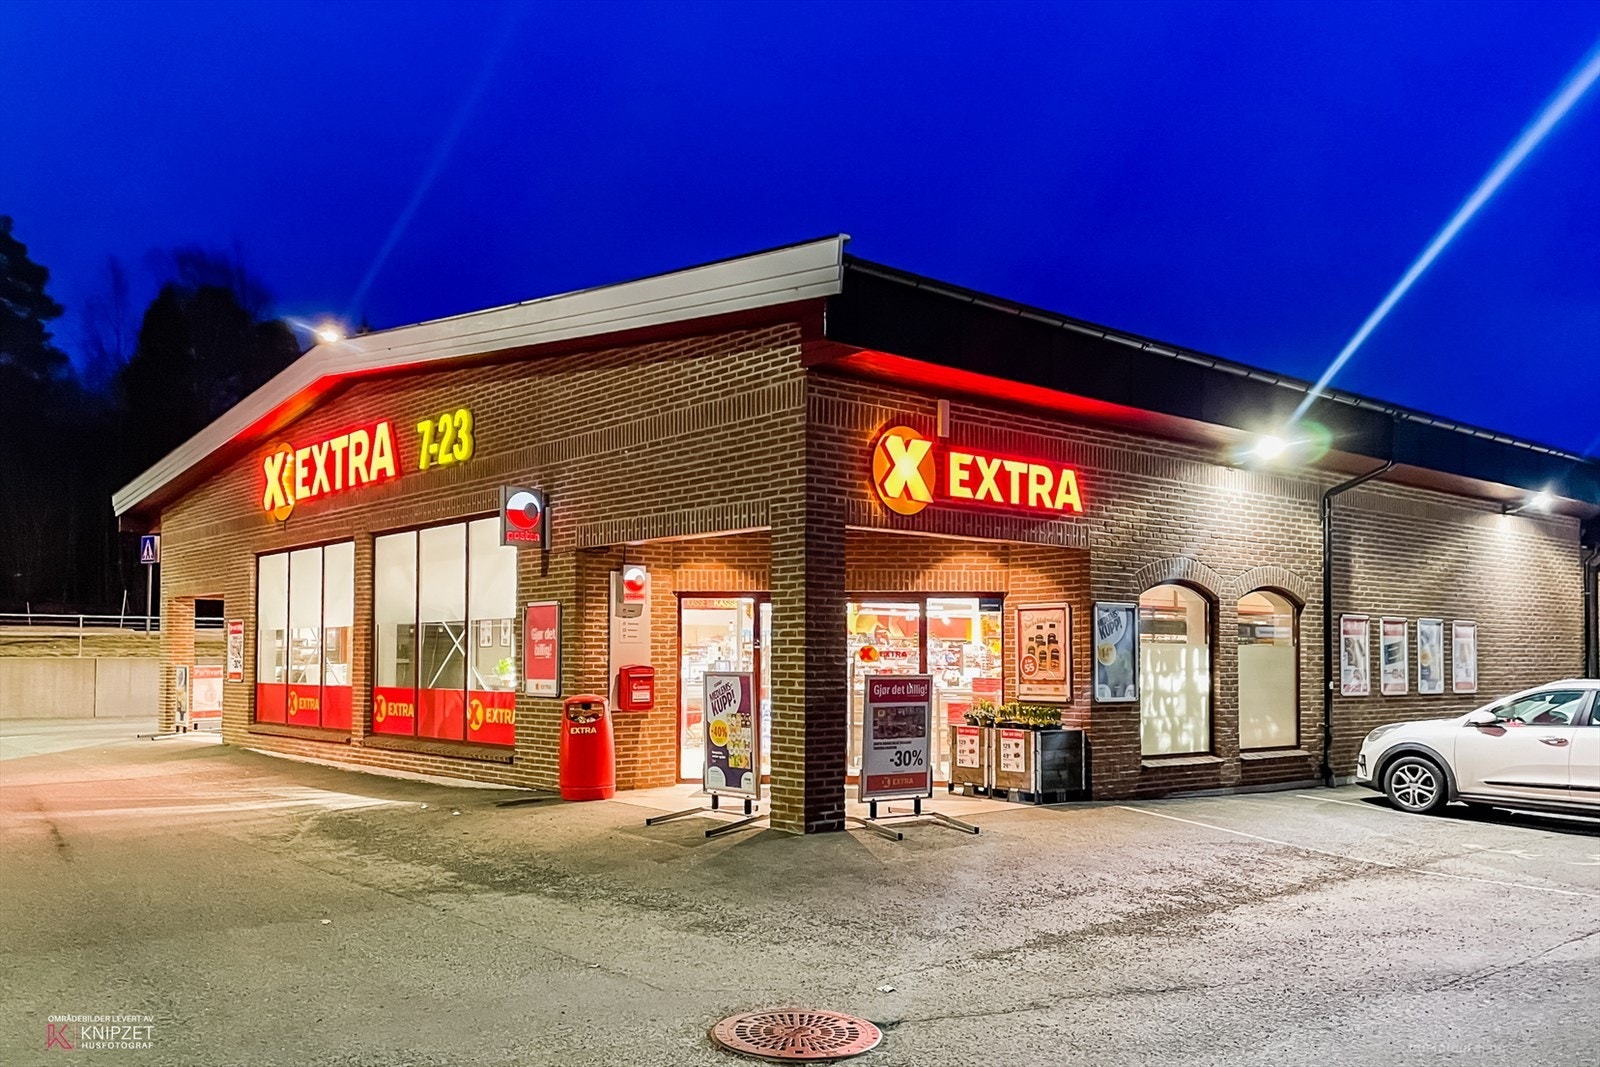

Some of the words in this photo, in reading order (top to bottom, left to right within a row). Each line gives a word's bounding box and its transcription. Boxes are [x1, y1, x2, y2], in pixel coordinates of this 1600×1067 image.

[417, 408, 474, 469] 7-23
[296, 421, 395, 500] EXTRA
[949, 451, 1083, 513] EXTRA
[506, 530, 540, 541] posten
[1099, 616, 1122, 640] KUPP!
[892, 685, 905, 695] det
[299, 697, 320, 711] EXTRA
[387, 702, 415, 718] EXTRA
[711, 689, 736, 717] KUPP!
[711, 726, 727, 738] -40%
[890, 750, 923, 767] -30%
